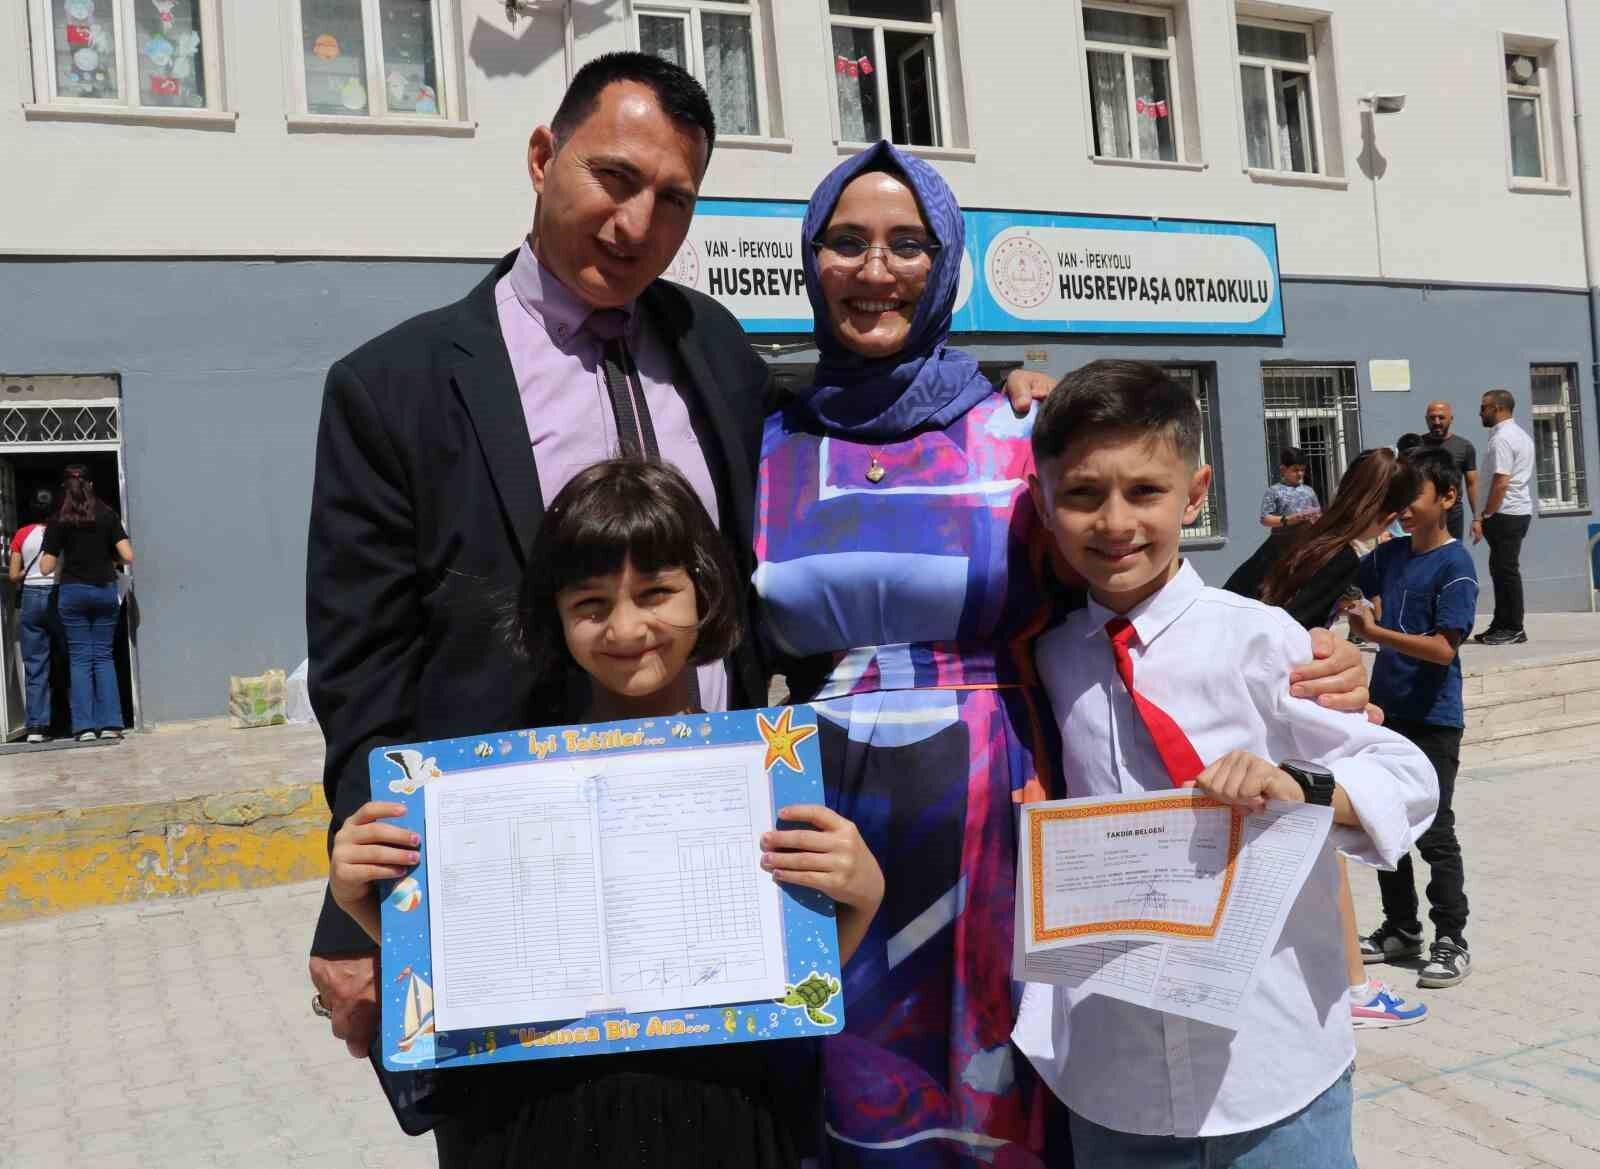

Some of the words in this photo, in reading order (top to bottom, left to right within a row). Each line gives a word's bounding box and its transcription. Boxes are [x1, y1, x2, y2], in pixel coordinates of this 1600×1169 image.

[704, 239, 729, 258] VAN
[738, 236, 793, 259] İPEKYOLU
[1057, 251, 1077, 268] VAN
[1085, 248, 1132, 270] İPEKYOLU
[708, 267, 806, 297] HUSREVP
[1059, 273, 1172, 305] HUSREVPAŞA
[1174, 277, 1269, 304] ORTAOKULU
[603, 1018, 640, 1041] Bir
